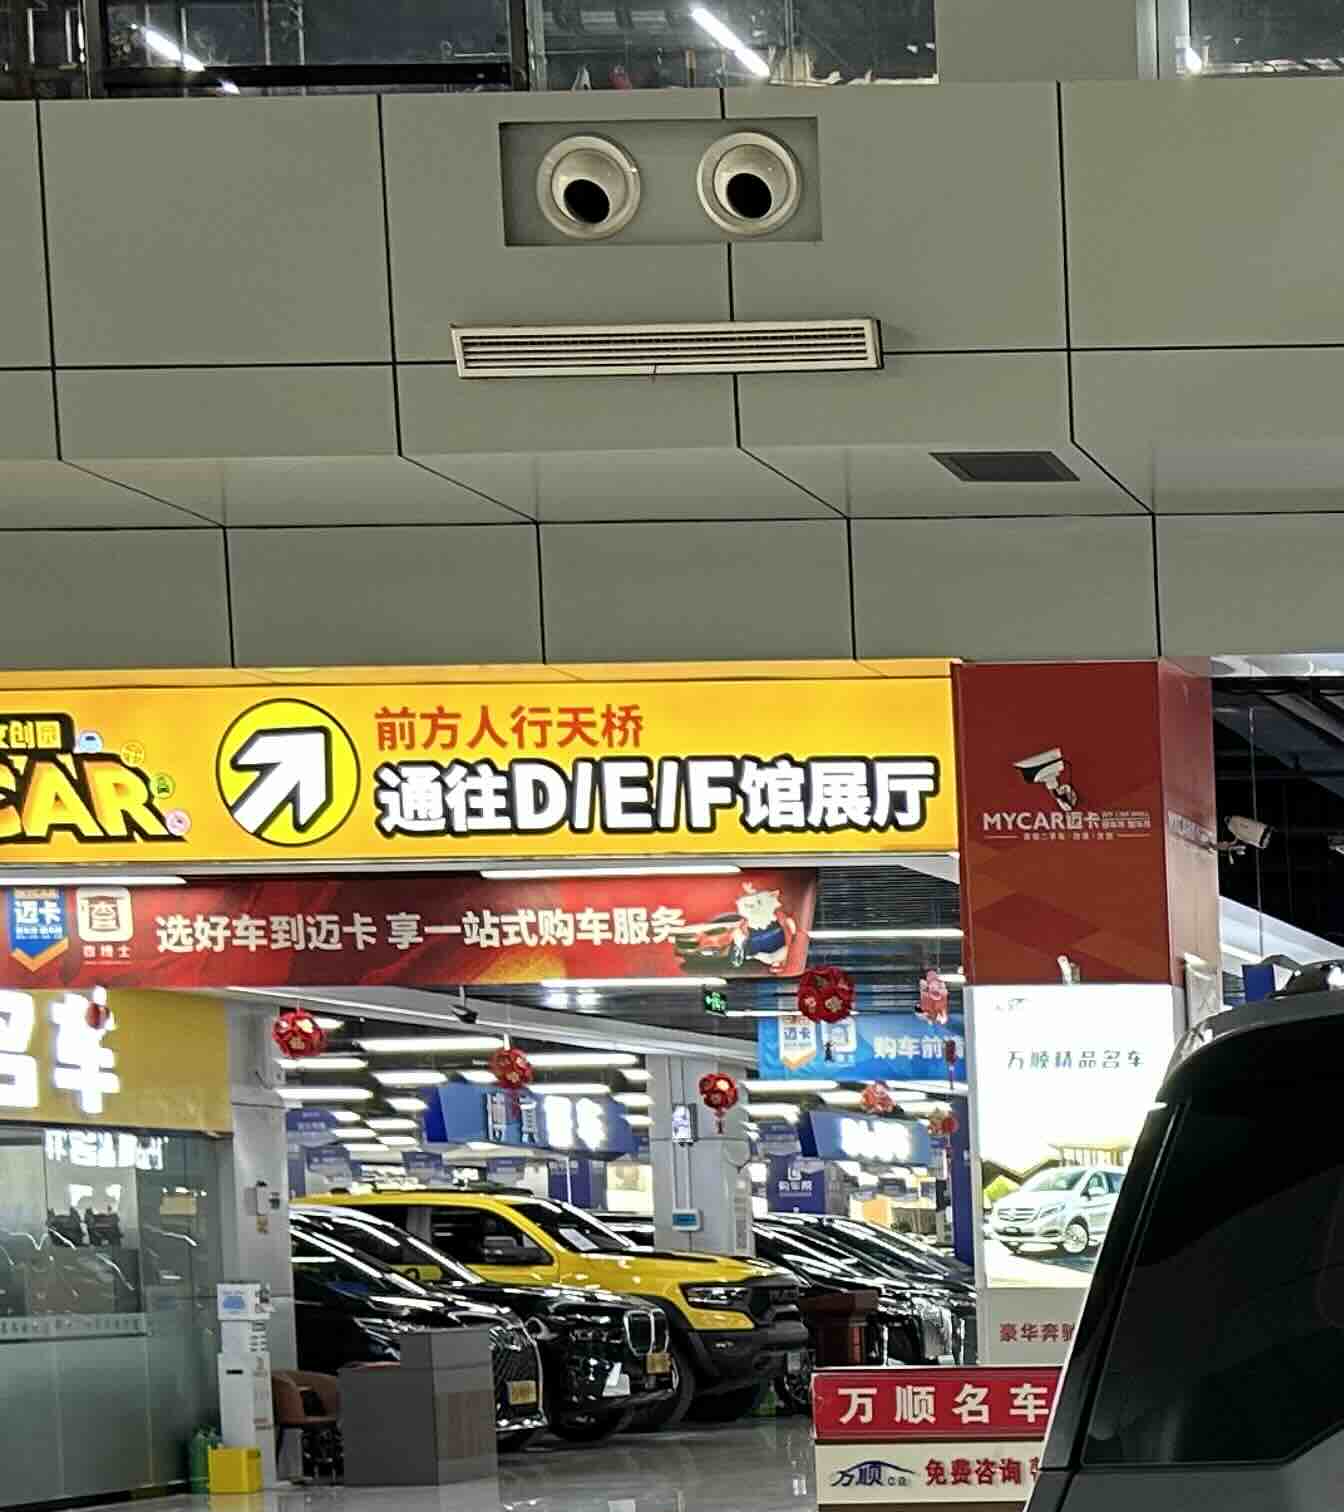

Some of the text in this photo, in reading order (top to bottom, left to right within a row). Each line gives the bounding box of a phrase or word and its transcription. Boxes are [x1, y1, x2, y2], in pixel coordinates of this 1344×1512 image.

[375, 704, 643, 752] 前方人行天桥
[376, 756, 938, 836] 通往D/E/F馆展厅
[155, 906, 686, 954] 选好车到迈卡 享一站式购车服务
[1007, 1050, 1144, 1070] 万顺精品名车
[837, 1383, 1050, 1425] 万顺名车
[925, 1457, 1022, 1486] 免费咨询
